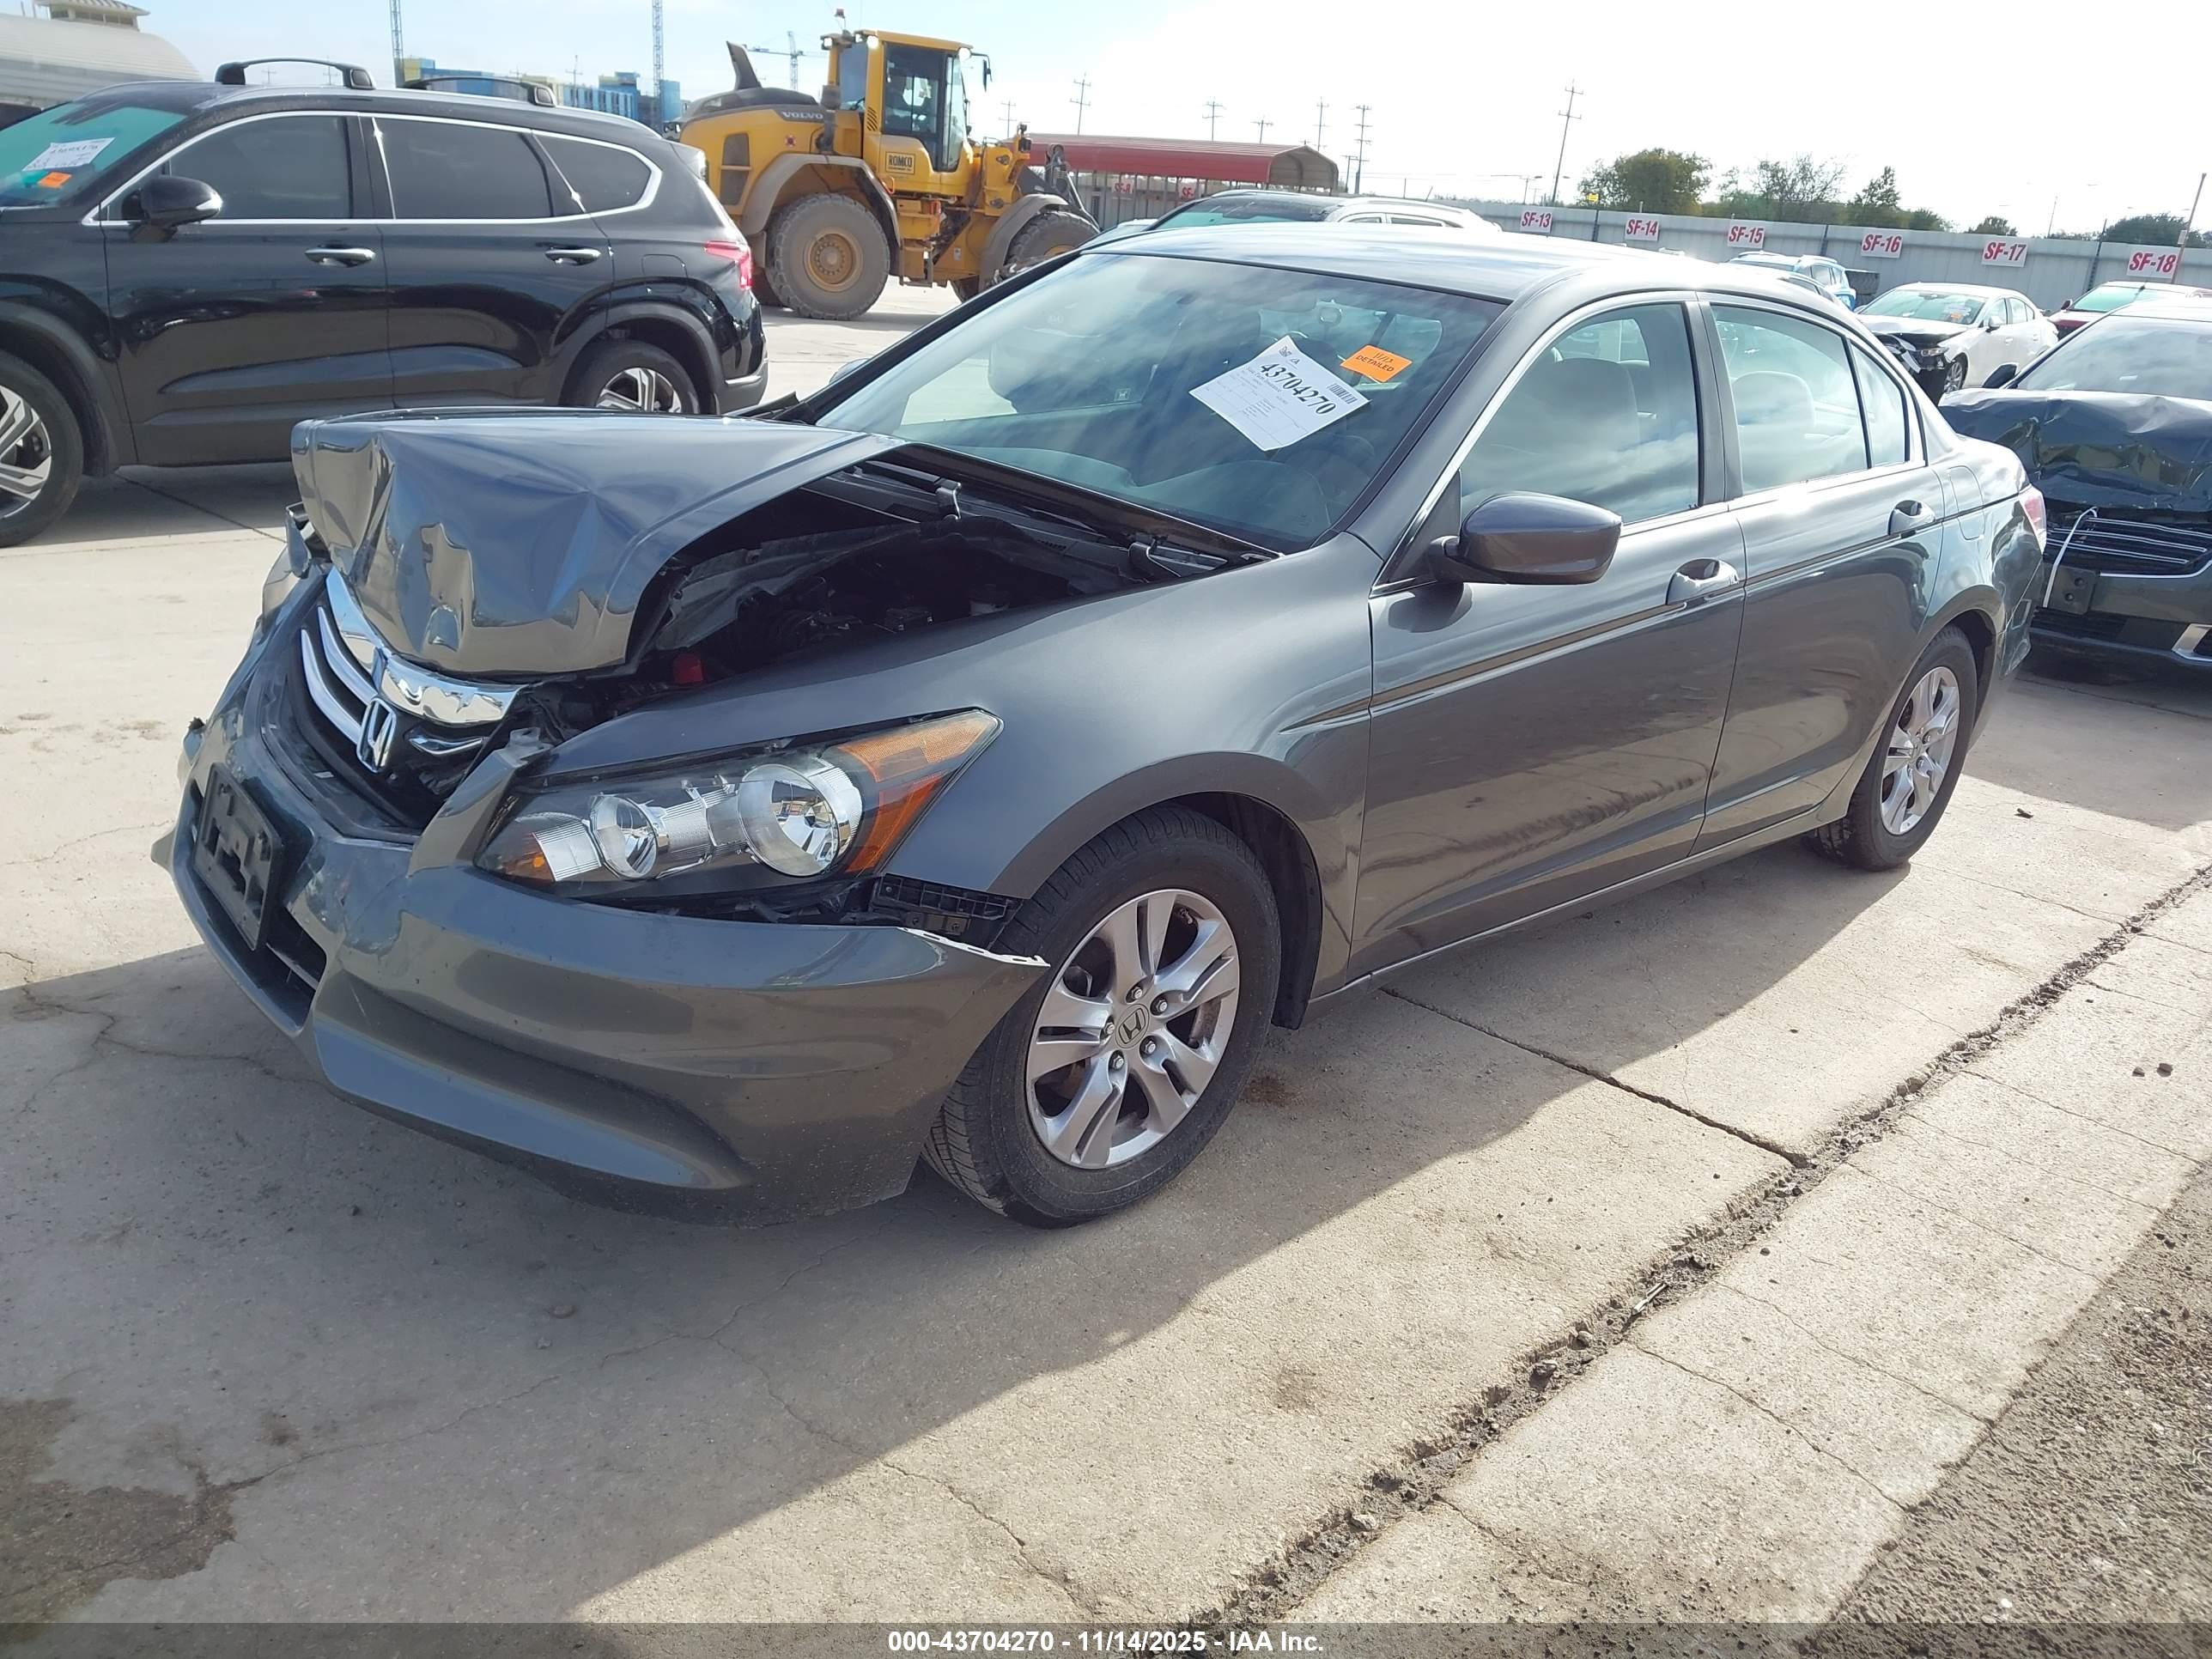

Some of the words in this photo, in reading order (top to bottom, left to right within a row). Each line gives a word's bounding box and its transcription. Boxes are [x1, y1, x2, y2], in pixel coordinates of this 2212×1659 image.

[781, 111, 824, 119] VOLVO
[888, 155, 913, 167] ROMCO
[1522, 211, 1552, 228] SF-13
[1626, 219, 1658, 236] SF-14
[1728, 226, 1764, 244] SF-15
[1862, 234, 1902, 253] SF-16
[1984, 241, 2027, 261] SF-17
[2129, 252, 2177, 273] SF-18
[1355, 355, 1395, 372] DETAILED
[1260, 364, 1337, 415] 43704270
